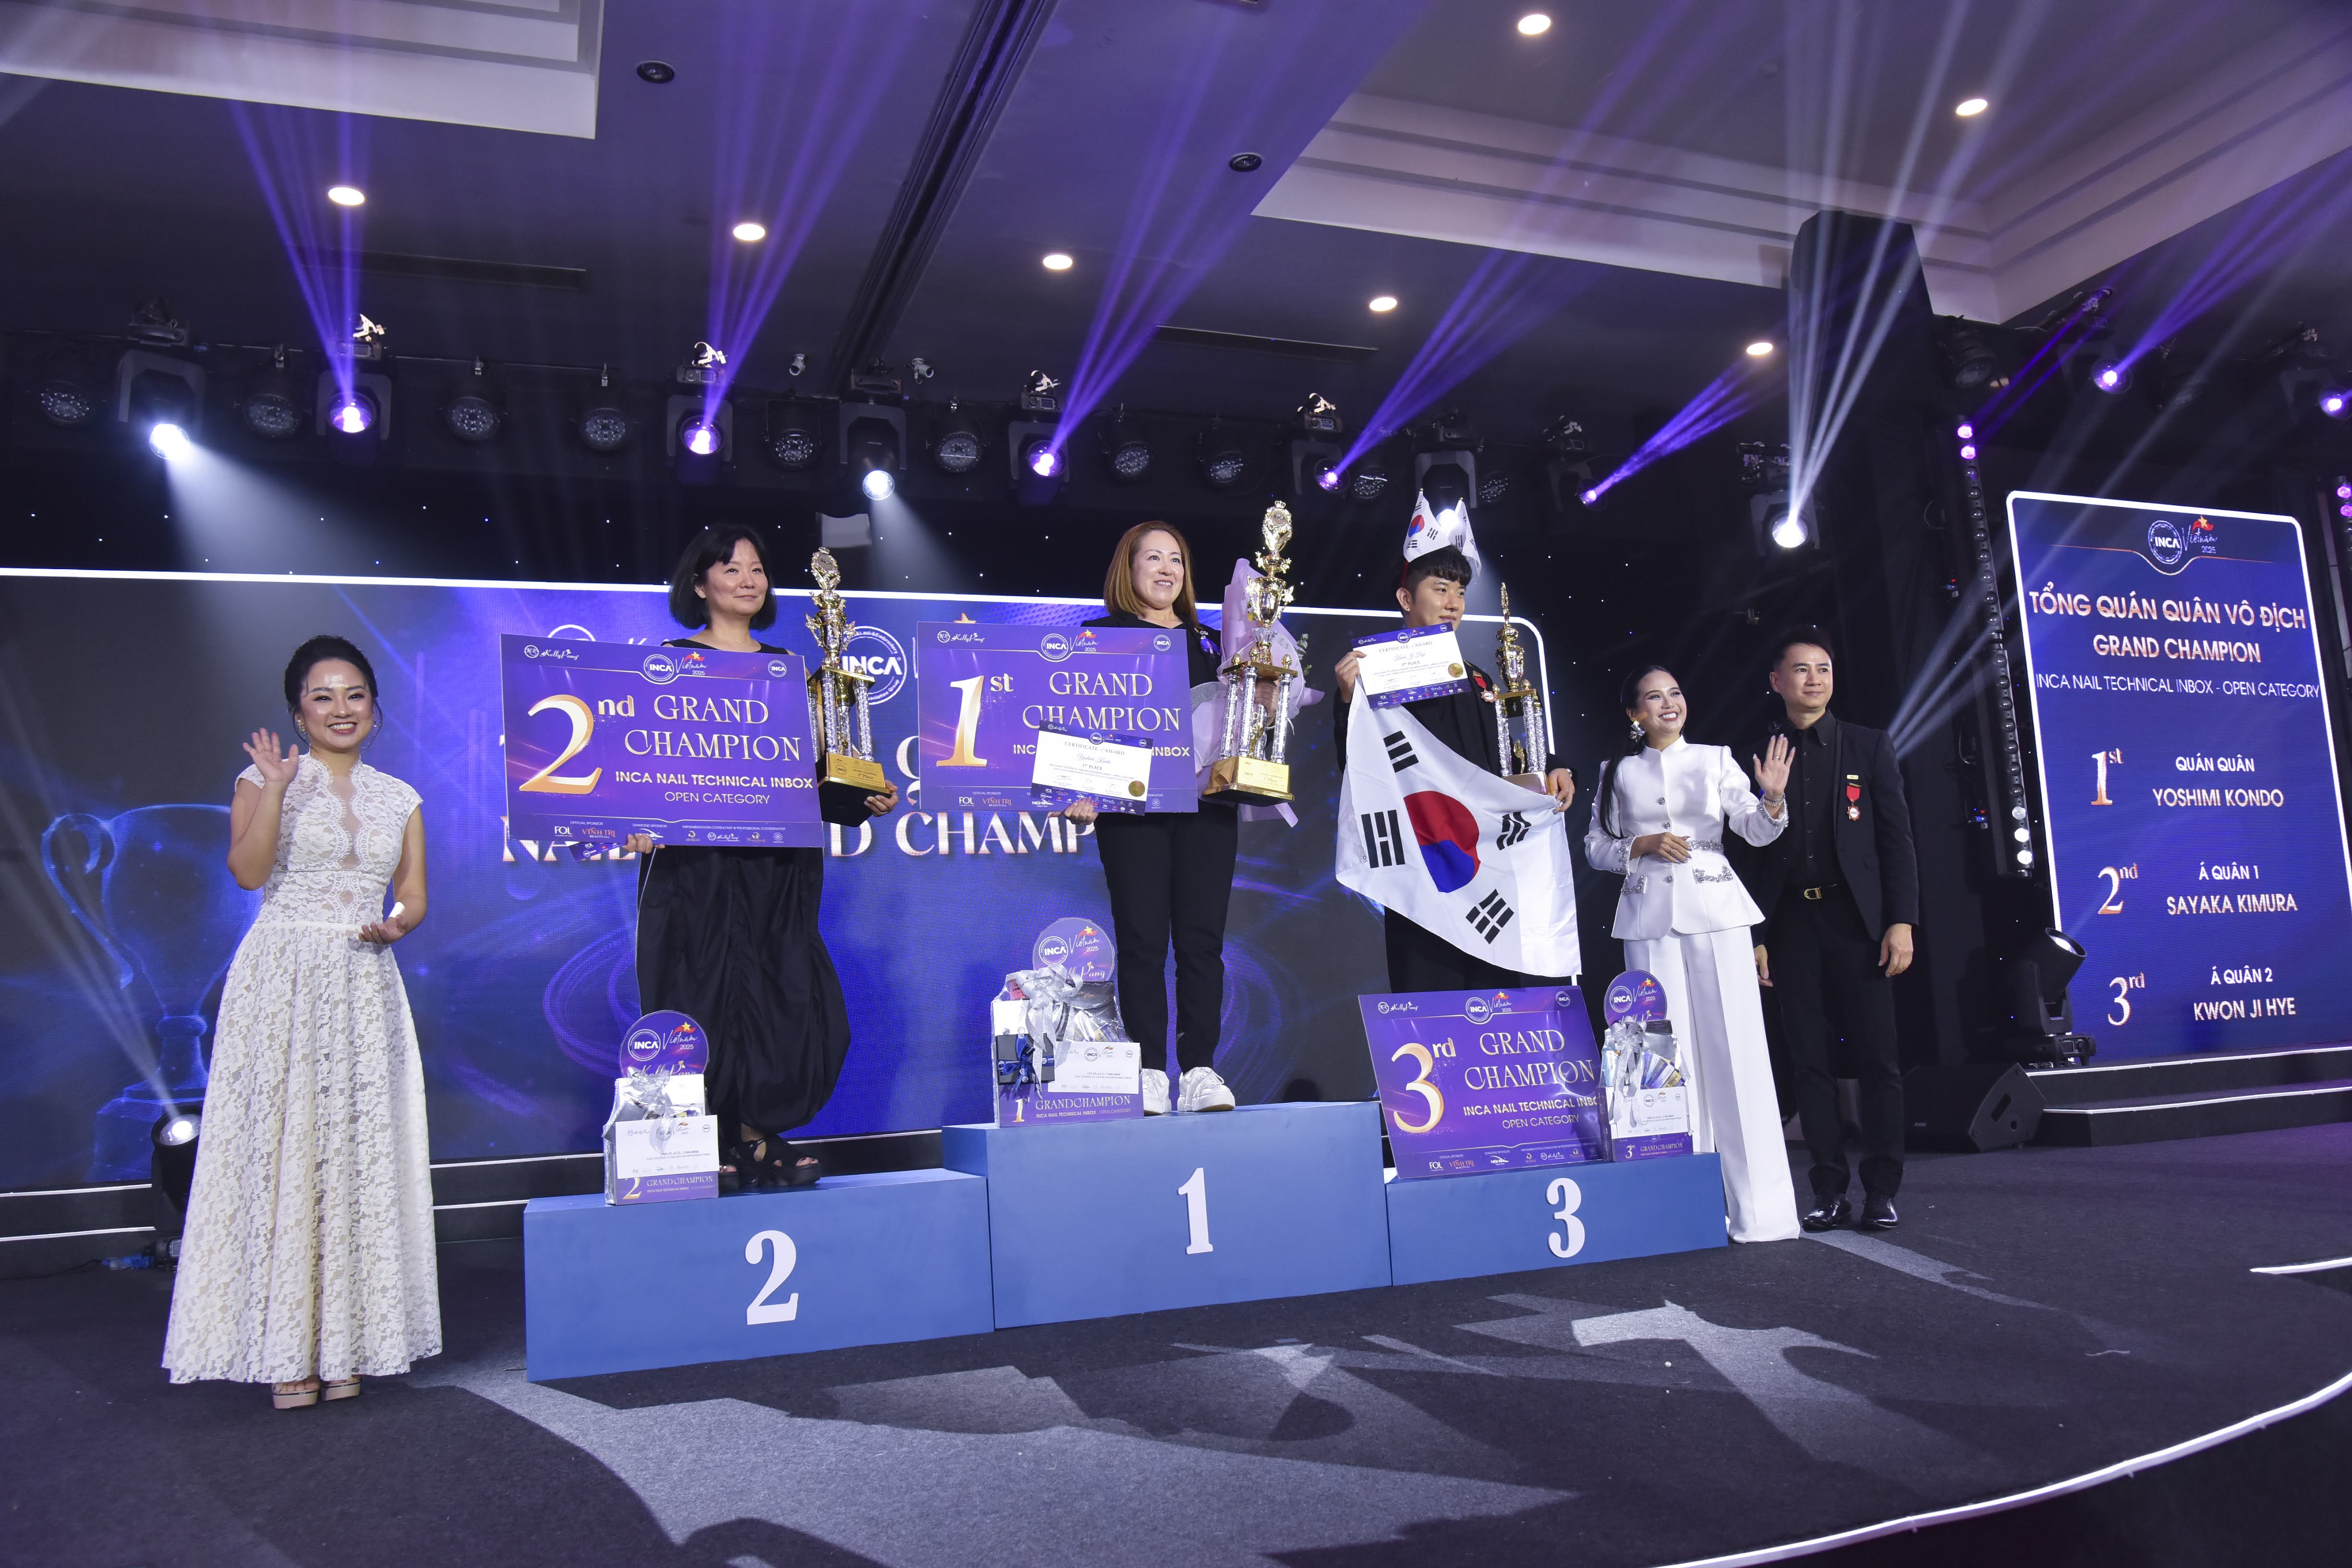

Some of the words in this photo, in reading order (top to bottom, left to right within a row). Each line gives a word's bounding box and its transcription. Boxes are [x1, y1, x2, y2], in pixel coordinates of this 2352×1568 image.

[2155, 536, 2180, 548] INCA
[2201, 546, 2216, 554] 2025
[2029, 582, 2091, 616] TỔNG
[2097, 591, 2158, 620] QUÁN
[2163, 596, 2220, 623] QUÂN
[2224, 600, 2255, 626] VÔ
[1070, 635, 1099, 651] Vietnam
[1379, 644, 1409, 653] CERTIFICATE
[2093, 634, 2159, 658] GRAND
[2164, 638, 2261, 663] CHAMPION
[649, 664, 672, 672] INCA
[675, 657, 707, 673] Vietnam
[841, 656, 903, 675] INCA
[2036, 673, 2070, 689] INCA
[2073, 675, 2102, 690] NAIL
[2104, 676, 2173, 693] TECHNICAL
[2176, 679, 2213, 694] INBOX
[2223, 681, 2255, 696] OPEN
[2258, 682, 2320, 698] CATEGORY
[935, 671, 1014, 767] 1st
[1049, 670, 1153, 697] GRAND
[1022, 704, 1181, 732] CHAMPION
[519, 694, 635, 795] 2nd
[654, 694, 769, 724] GRAND
[624, 729, 801, 762] CHAMPION
[1013, 744, 1036, 756] INC
[1152, 747, 1190, 757] INBOX
[1065, 741, 1098, 751] CERTIFICATE
[615, 771, 654, 784] INCA
[656, 773, 689, 785] NAIL
[692, 774, 768, 788] TECHNICAL
[771, 776, 814, 789] INBOX
[2091, 747, 2124, 805] 1st
[2175, 753, 2214, 772] QUÁN
[2217, 754, 2255, 772] QUÂN
[665, 791, 701, 803] OPEN
[703, 793, 771, 805] CATEGORY
[2152, 789, 2221, 807] YOSHIMI
[2226, 789, 2284, 807] KONDO
[555, 826, 572, 835] FOL
[895, 812, 1095, 856] CHAMP
[2097, 863, 2138, 915] 2nd
[2198, 862, 2208, 880] Á
[2211, 862, 2250, 880] QUÂN
[2254, 865, 2259, 879] 1
[2167, 895, 2233, 915] SAYAKA
[2237, 893, 2298, 913] KIMURA
[1044, 946, 1067, 956] INCA
[1069, 934, 1101, 954] Vietnam
[1488, 997, 1512, 1013] Vietnam
[1613, 995, 1631, 1003] INCA
[1633, 985, 1657, 1002] Vietnam
[2108, 972, 2145, 1026] 3rd
[2211, 966, 2221, 985] Á
[2223, 965, 2262, 984] QUÂN
[2265, 968, 2273, 982] 2
[2194, 1001, 2244, 1021] KWON
[2249, 999, 2262, 1018] JI
[2266, 997, 2296, 1017] HYE
[634, 1041, 659, 1049] INCA
[663, 1030, 698, 1050] Vietnam
[1391, 1036, 1456, 1133] 3rd
[1479, 1029, 1565, 1056] GRAND
[1465, 1059, 1594, 1090] CHAMPION
[1463, 1104, 1491, 1116] INCA
[1493, 1102, 1517, 1114] NAIL
[1518, 1098, 1575, 1112] TECHNICAL
[1576, 1096, 1598, 1107] INB
[1502, 1118, 1528, 1130] OPEN
[1530, 1114, 1579, 1127] CATEGORY
[1429, 1161, 1443, 1169] FOL
[1177, 1167, 1213, 1254] 1
[1546, 1178, 1585, 1258] 3
[745, 1230, 799, 1325] 2
